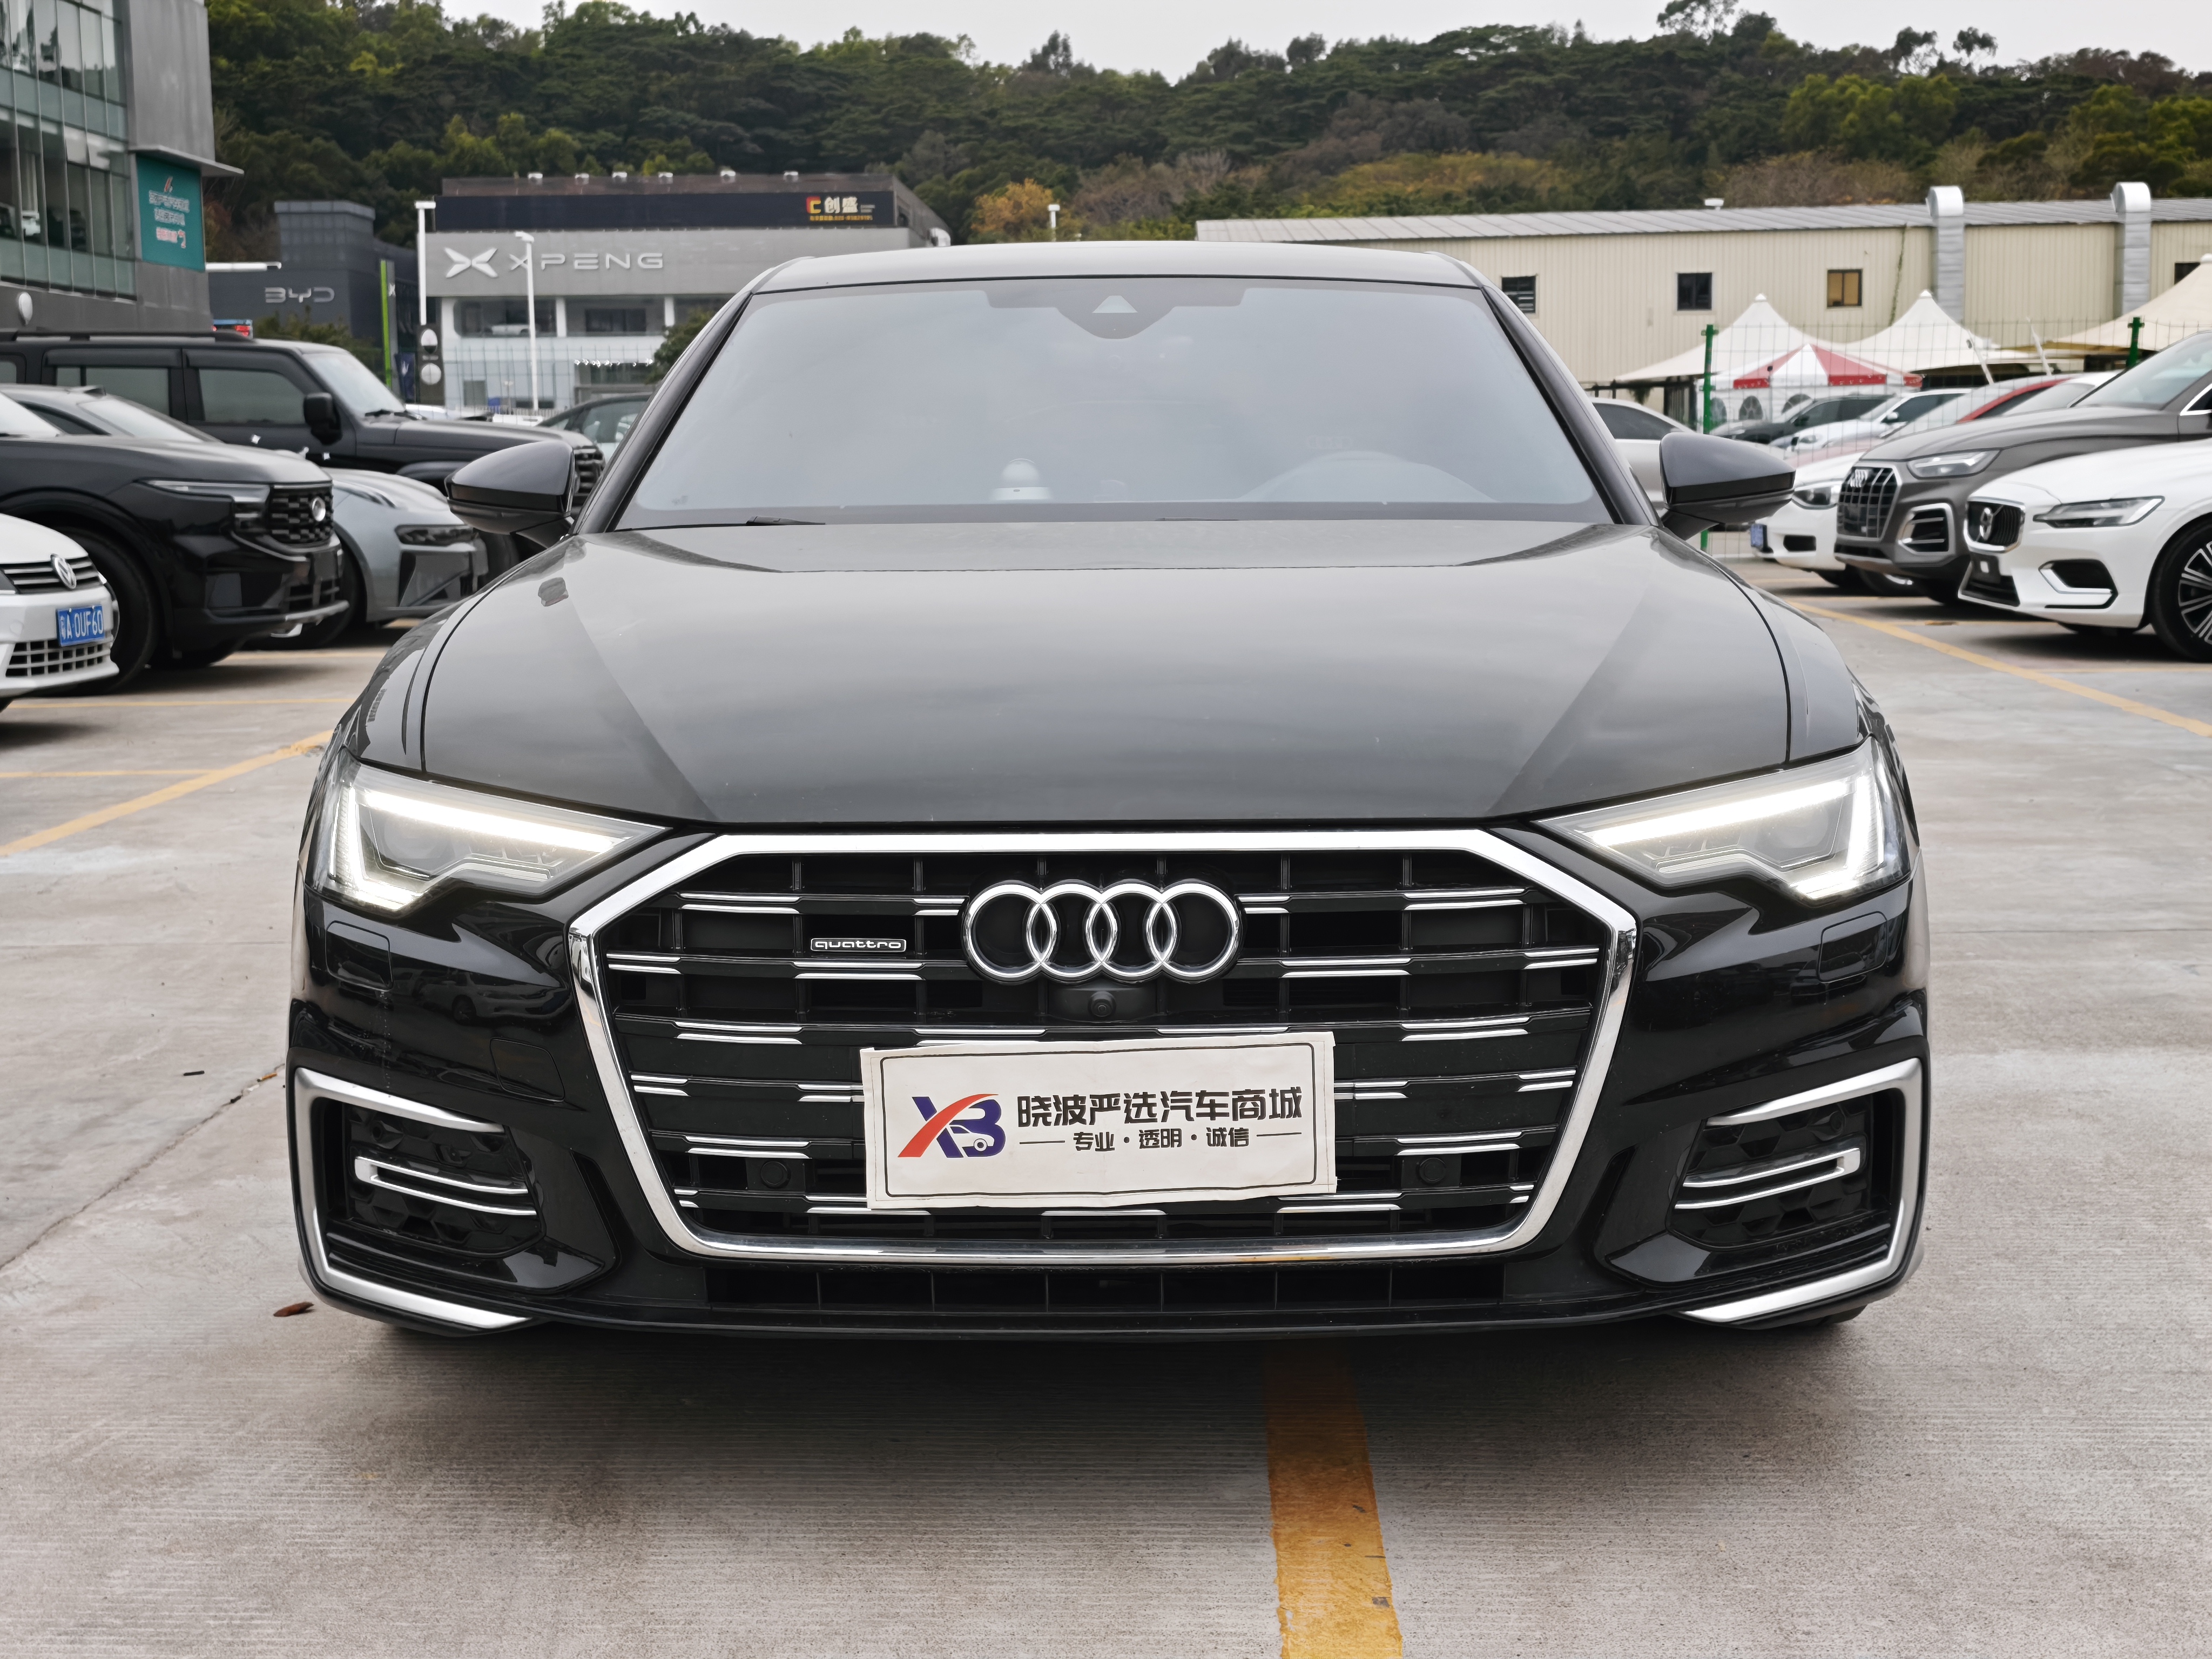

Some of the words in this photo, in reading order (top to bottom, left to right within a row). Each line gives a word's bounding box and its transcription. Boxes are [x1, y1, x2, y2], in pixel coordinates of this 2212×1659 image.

[509, 253, 663, 271] XPENG
[265, 287, 335, 303] BYD
[815, 940, 901, 949] quattro
[1017, 1087, 1303, 1128] 晓波严选汽车商城
